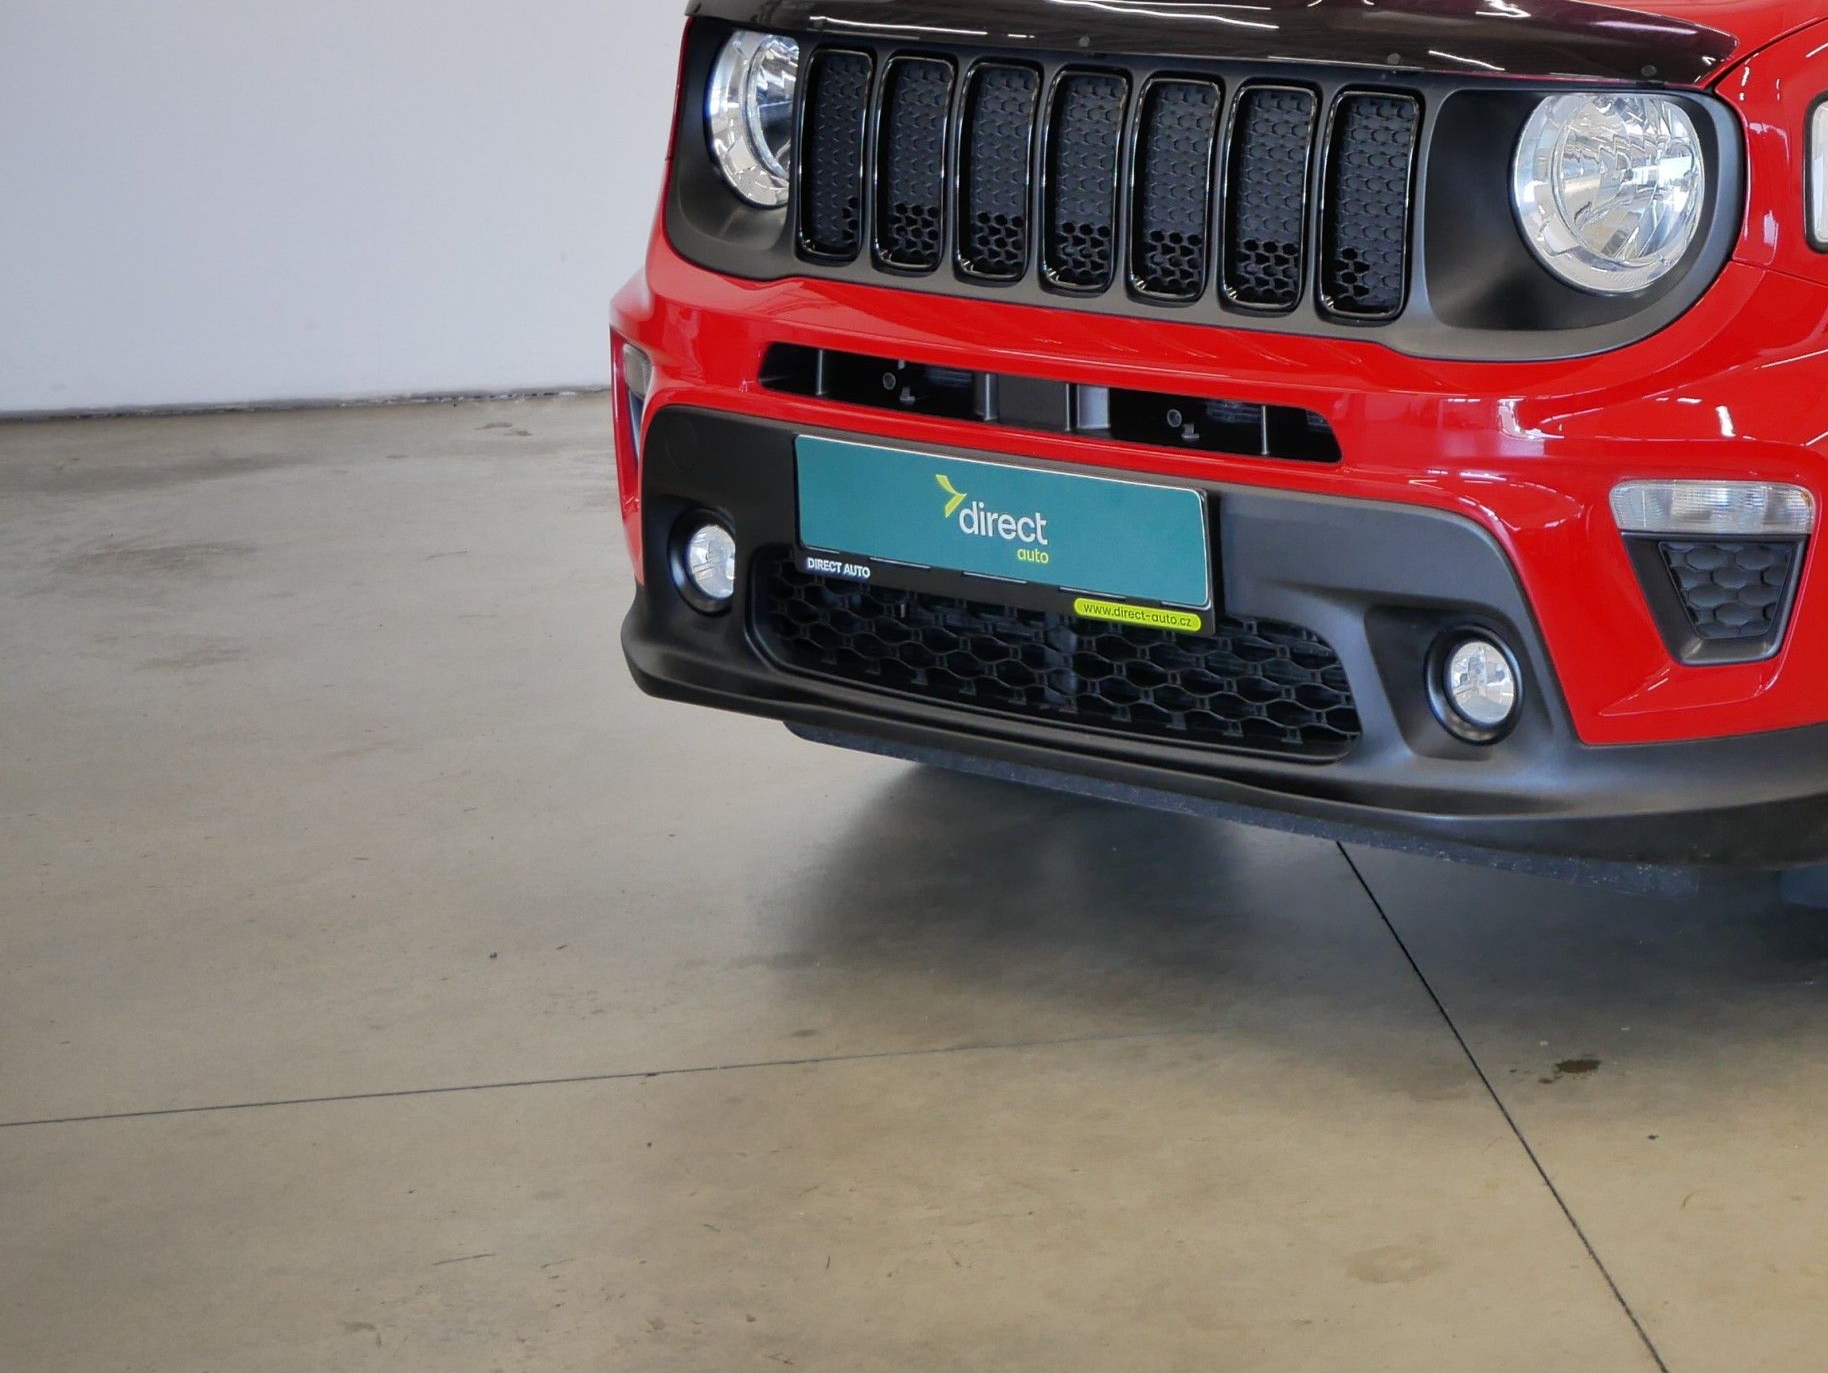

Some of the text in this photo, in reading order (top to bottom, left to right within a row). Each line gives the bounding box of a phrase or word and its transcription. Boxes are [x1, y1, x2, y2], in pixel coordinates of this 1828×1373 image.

[959, 501, 1048, 545] direct
[807, 557, 871, 578] DIRECT AUTO
[1017, 548, 1049, 564] auto
[1083, 602, 1192, 627] www.direct-auto.cz
